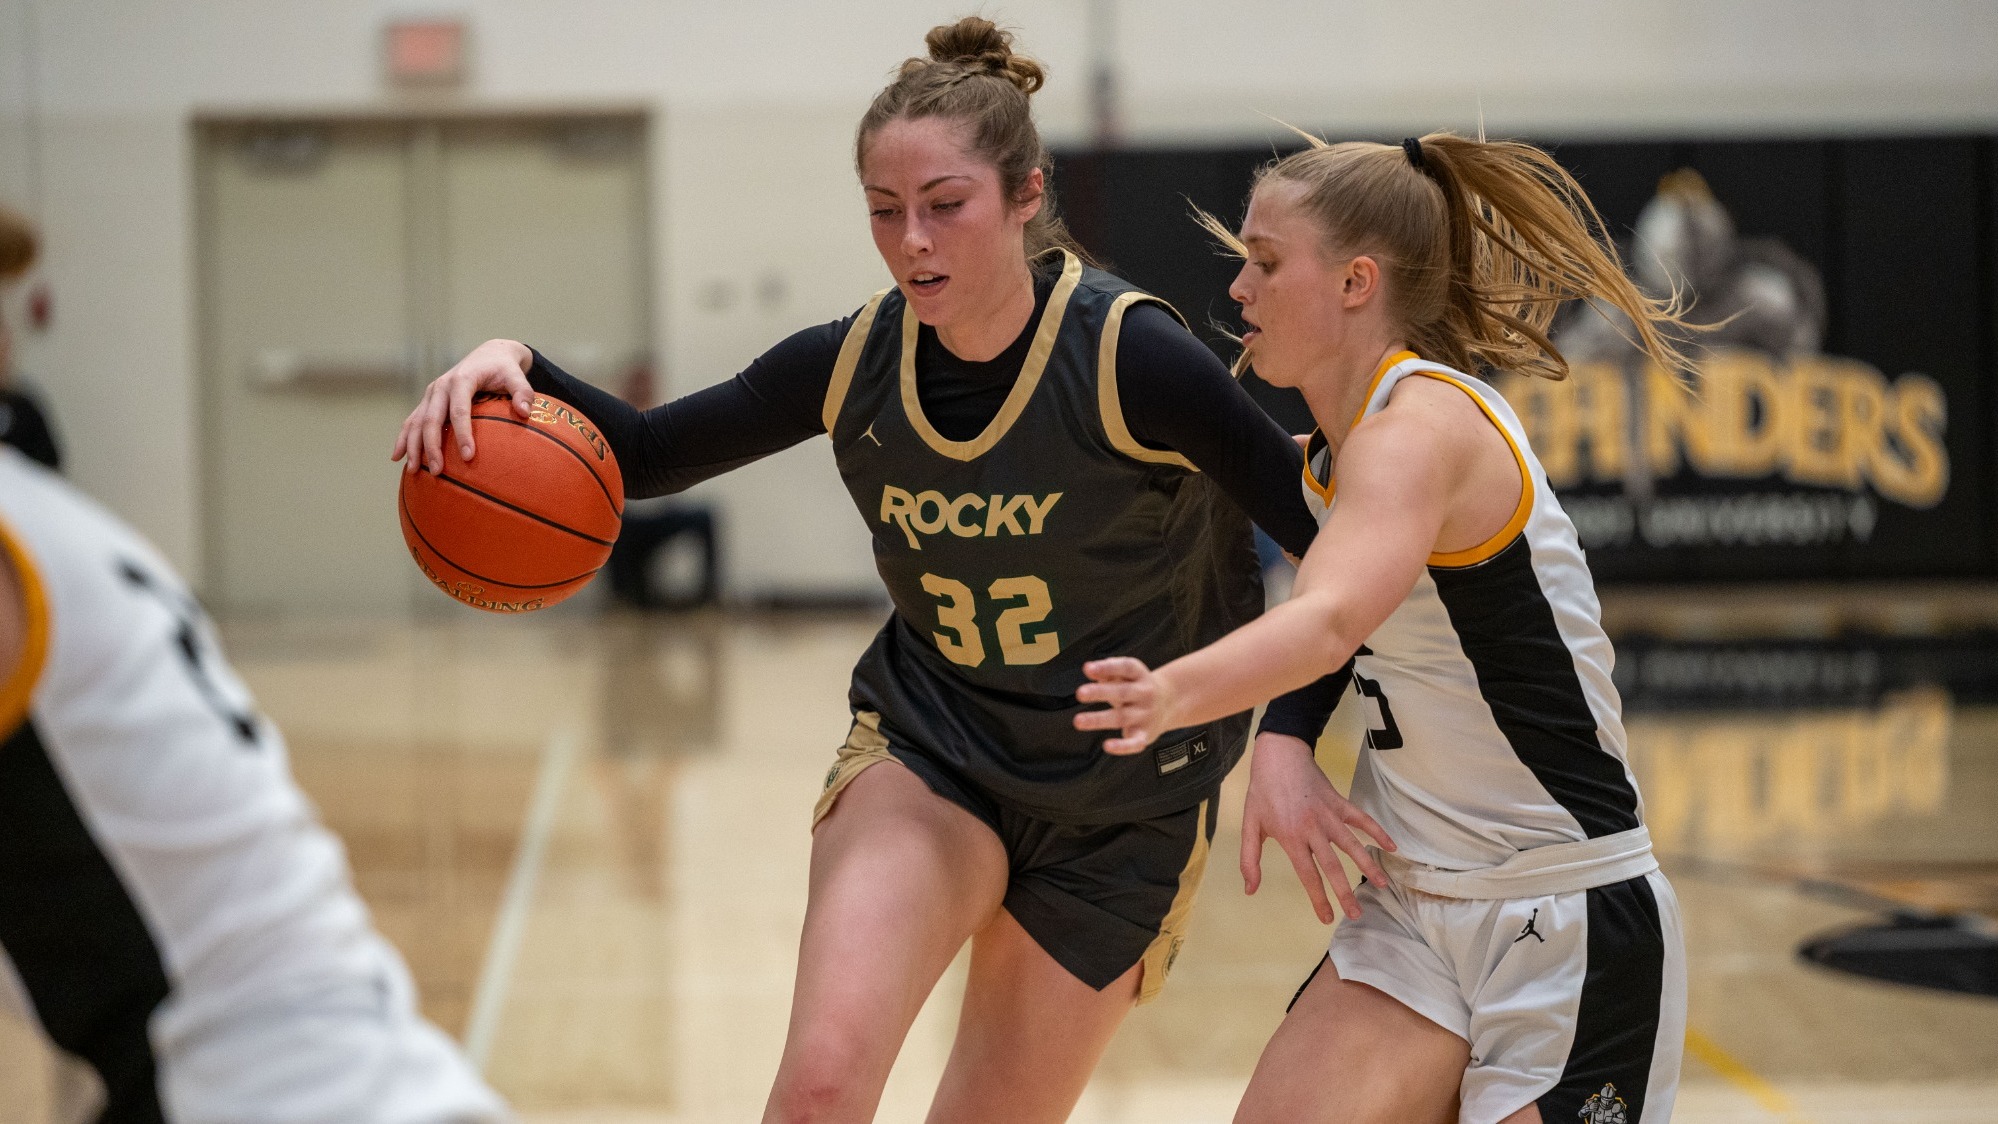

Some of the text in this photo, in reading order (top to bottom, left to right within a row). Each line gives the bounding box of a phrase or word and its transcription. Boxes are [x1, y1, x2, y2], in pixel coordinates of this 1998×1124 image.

[880, 484, 1064, 550] ROCKY
[413, 546, 545, 612] SPALDING
[919, 572, 1061, 668] 32
[1193, 741, 1207, 756] XL
